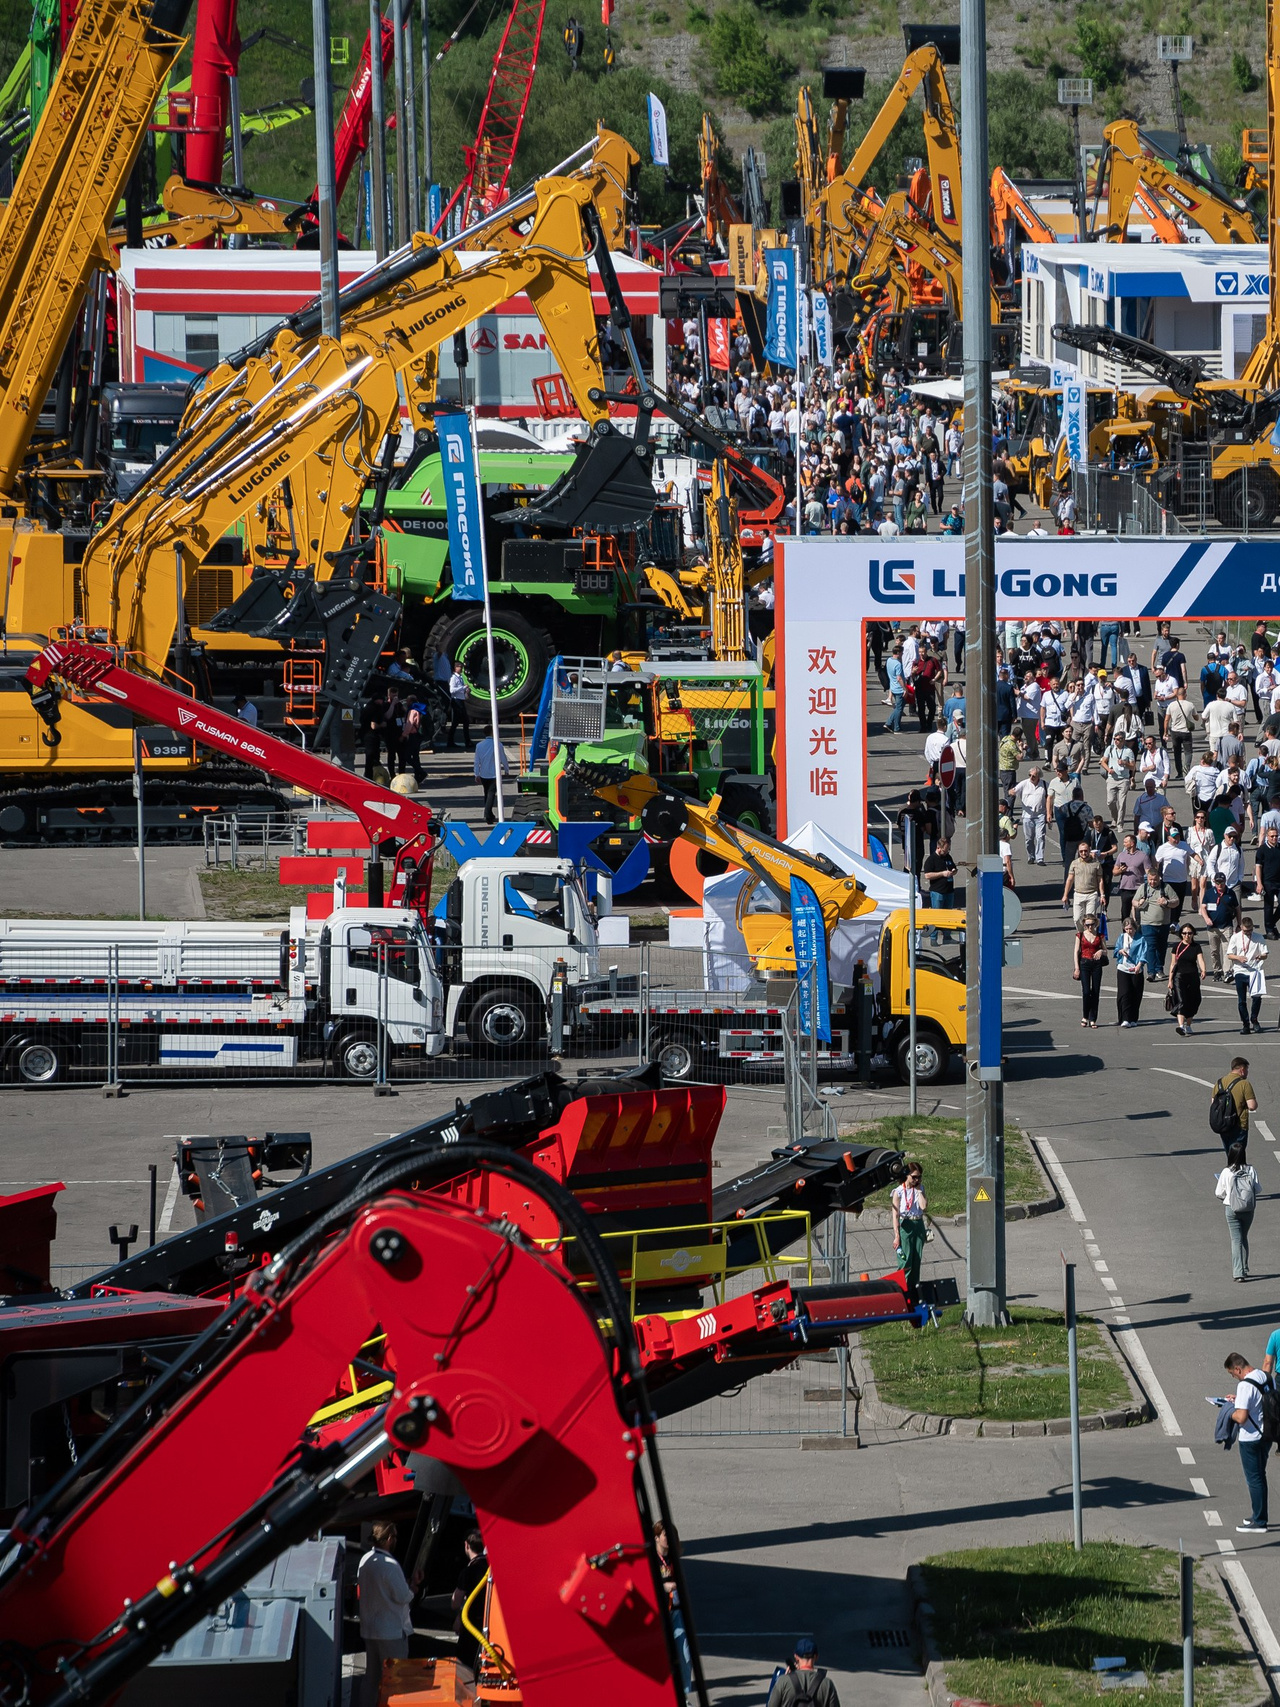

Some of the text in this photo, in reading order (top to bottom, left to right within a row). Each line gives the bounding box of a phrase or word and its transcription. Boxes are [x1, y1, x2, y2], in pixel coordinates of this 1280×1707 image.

[355, 66, 371, 99] SANY
[941, 189, 952, 216] XCMG
[1173, 191, 1191, 208] XCMG
[1015, 205, 1034, 228] DEVELON
[343, 656, 360, 683] LGB165
[808, 645, 838, 797] 欢迎光临
[153, 745, 187, 755] 939F
[195, 720, 267, 760] RUSMAN 805L
[751, 846, 793, 871] RUSMAN
